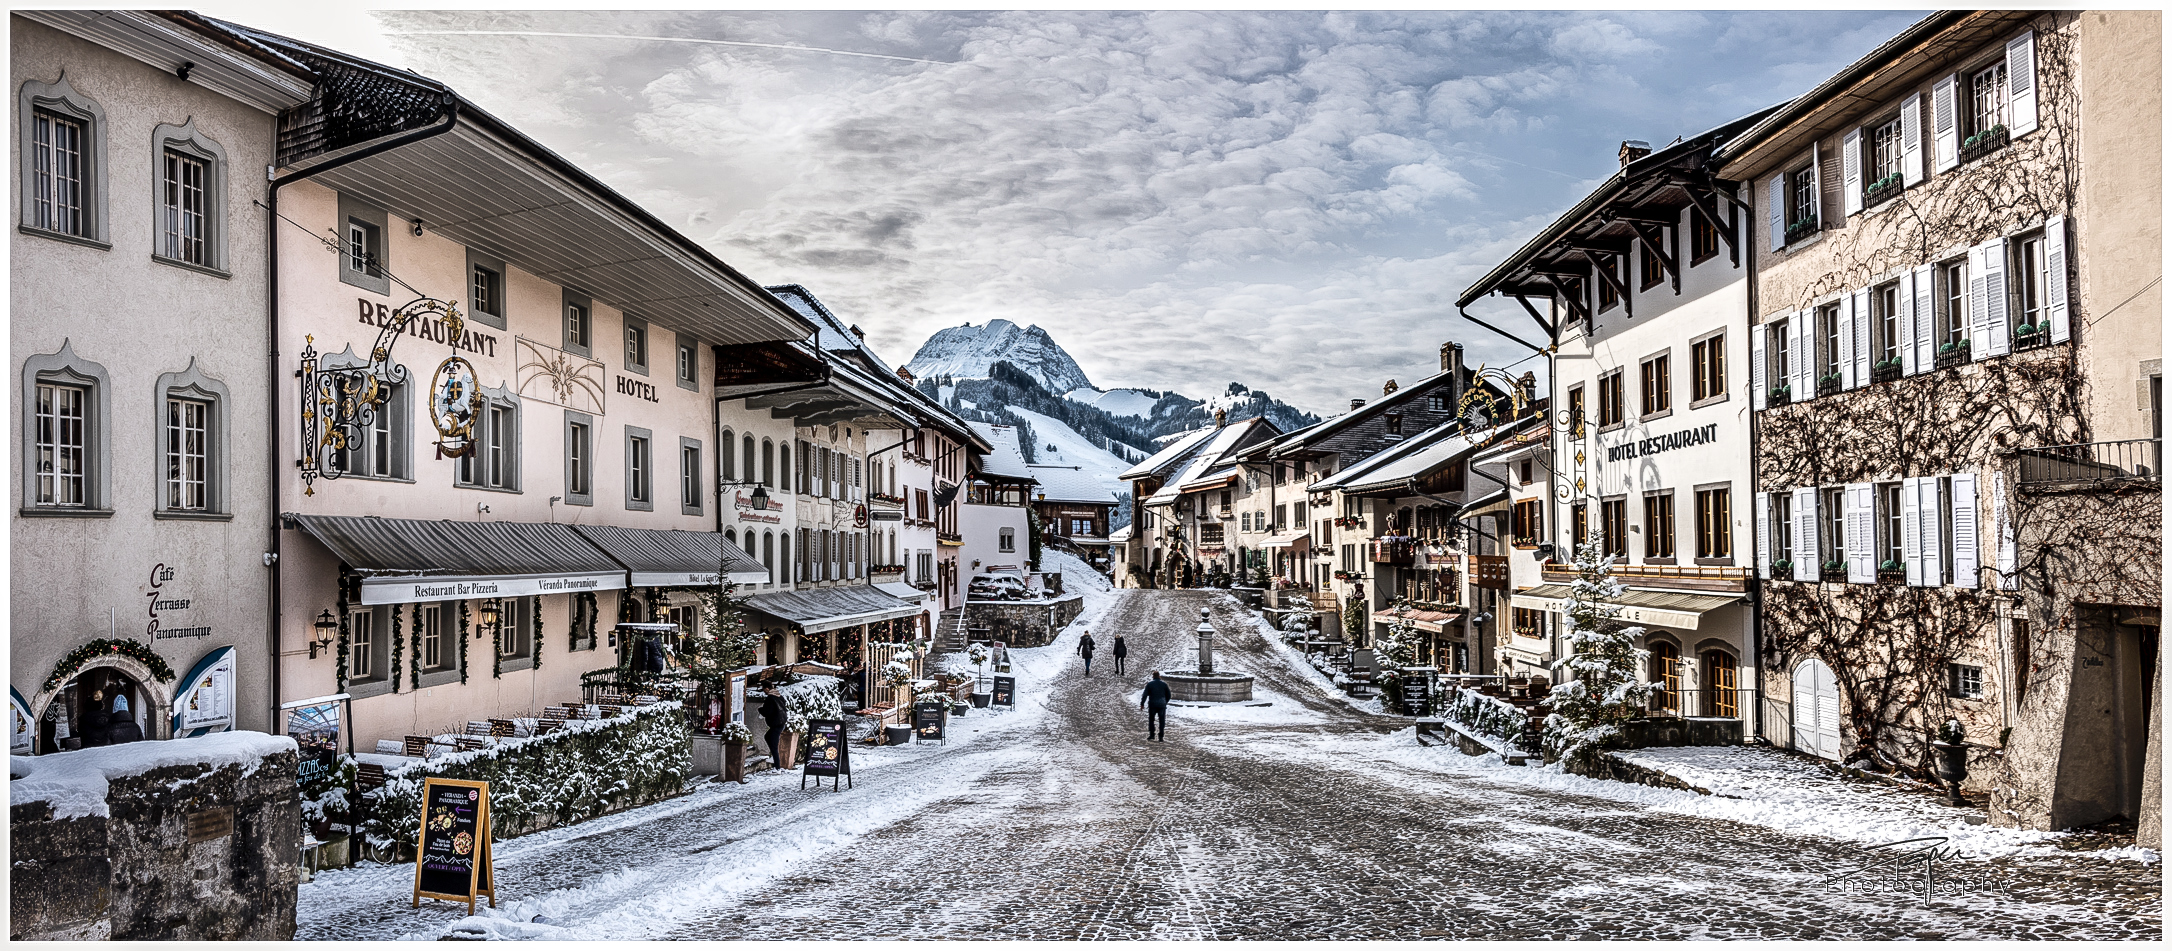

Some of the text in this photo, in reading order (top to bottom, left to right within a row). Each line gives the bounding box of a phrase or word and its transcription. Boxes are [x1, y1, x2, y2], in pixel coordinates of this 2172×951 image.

[358, 298, 498, 358] RESTAURANT
[616, 375, 659, 403] HOTEL
[1457, 394, 1499, 418] HOTEL DE VILLE
[1608, 423, 1718, 463] HOTEL RESTAURANT
[150, 563, 174, 588] Café
[415, 578, 598, 597] Restaurant Bar Pizzeria Véranda Panoramique
[689, 574, 699, 582] Hôtel
[146, 591, 190, 618] Terrasse
[1545, 602, 1564, 610] HOT
[147, 619, 211, 645] Panoramique
[298, 758, 320, 776] IZZAS
